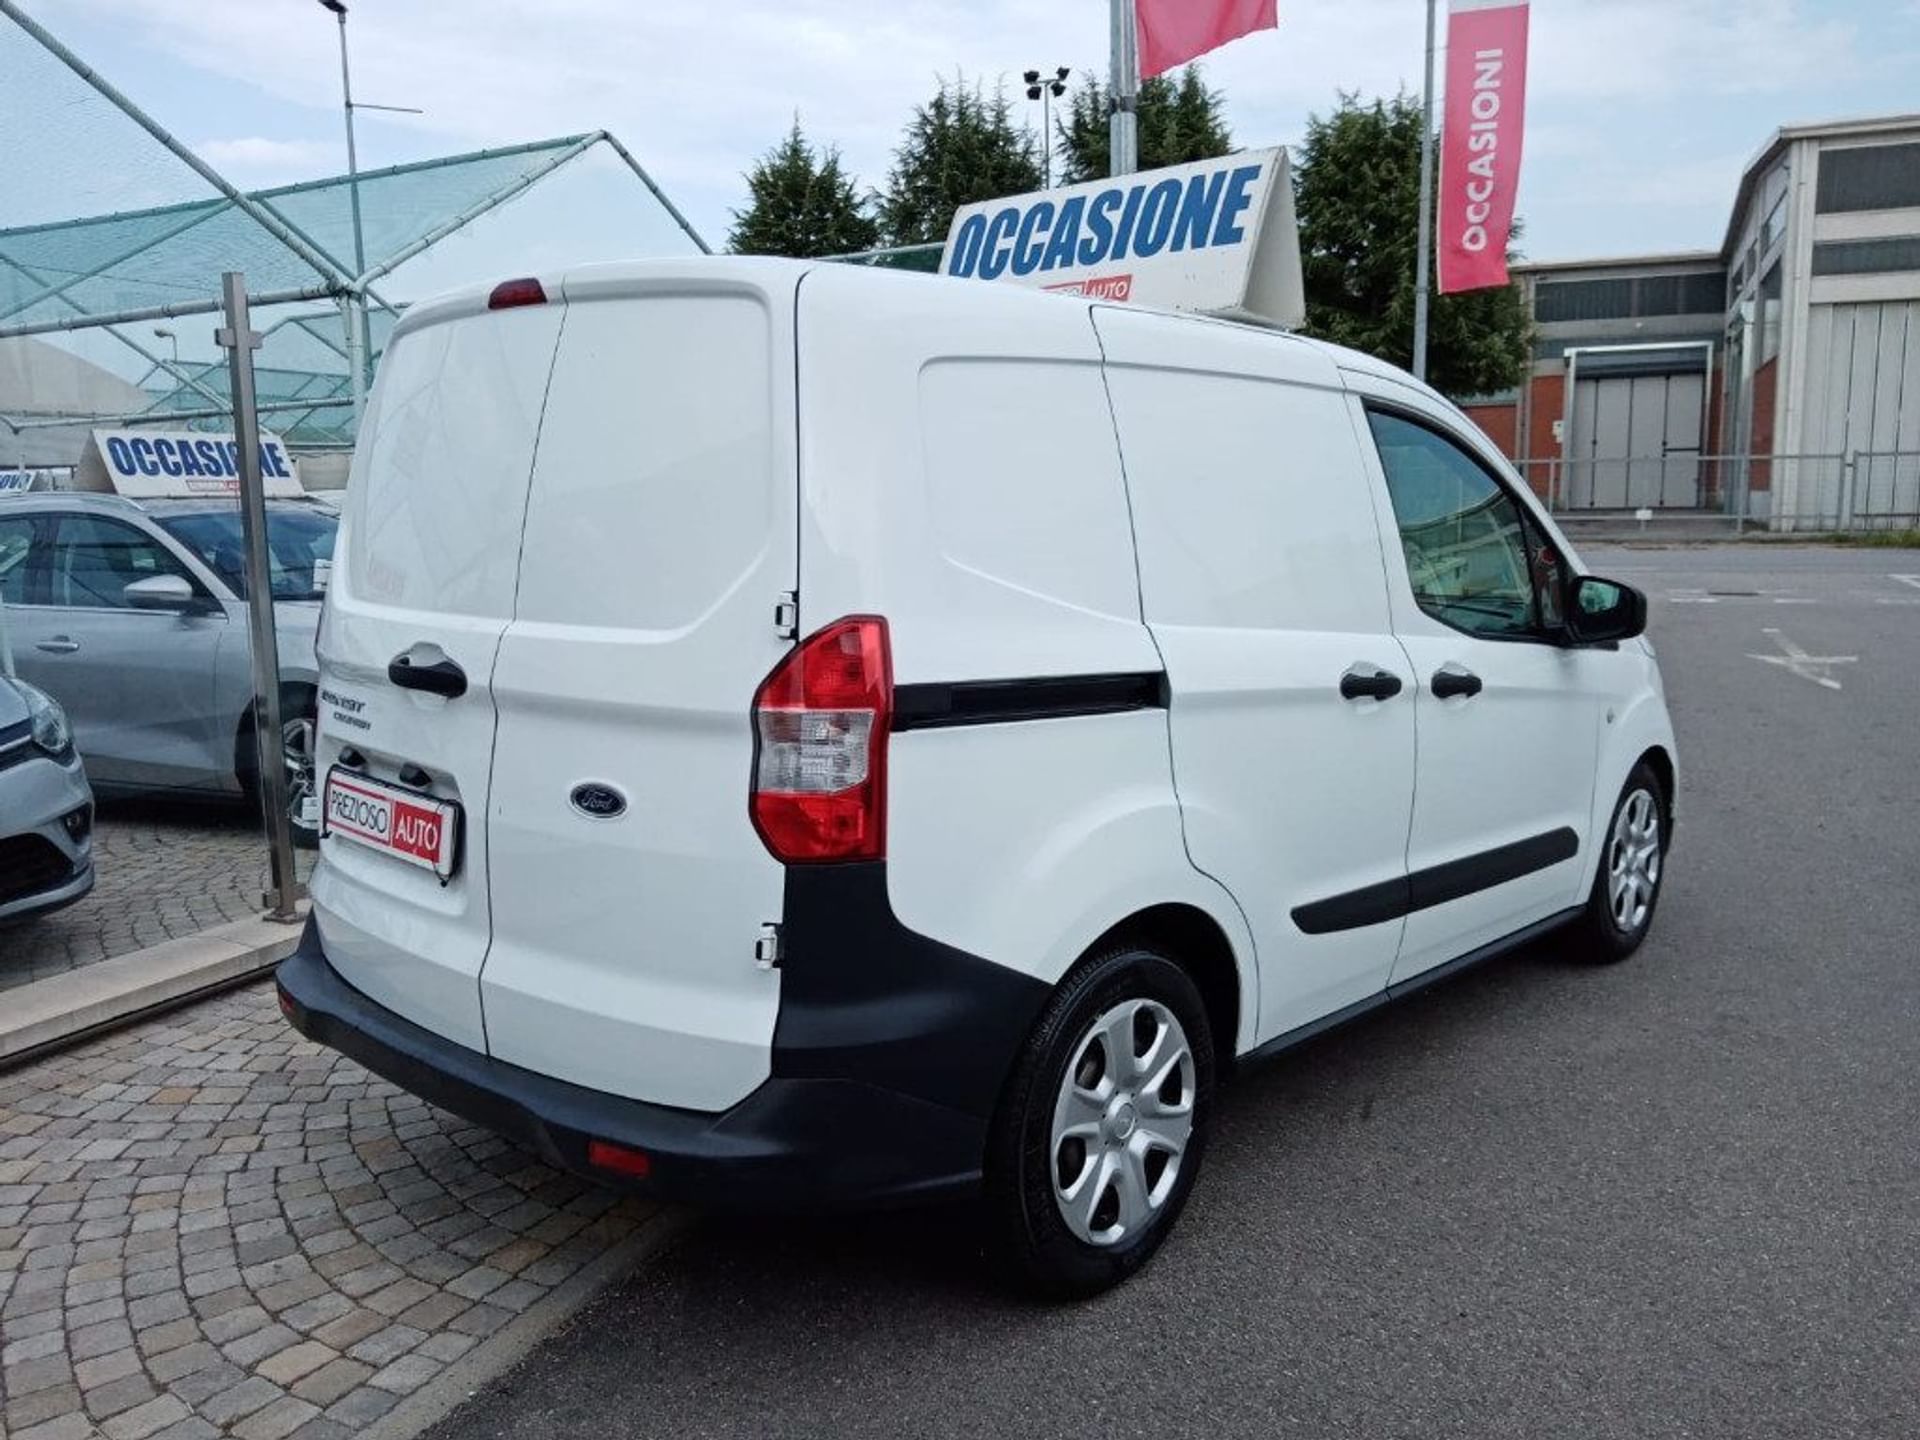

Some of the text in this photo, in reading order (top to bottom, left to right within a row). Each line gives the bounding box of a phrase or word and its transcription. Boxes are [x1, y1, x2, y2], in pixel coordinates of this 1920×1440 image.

[1462, 48, 1503, 252] OCCASIONI
[949, 165, 1262, 281] OCCASIONE
[330, 789, 438, 851] PREZIOSO AUTO
